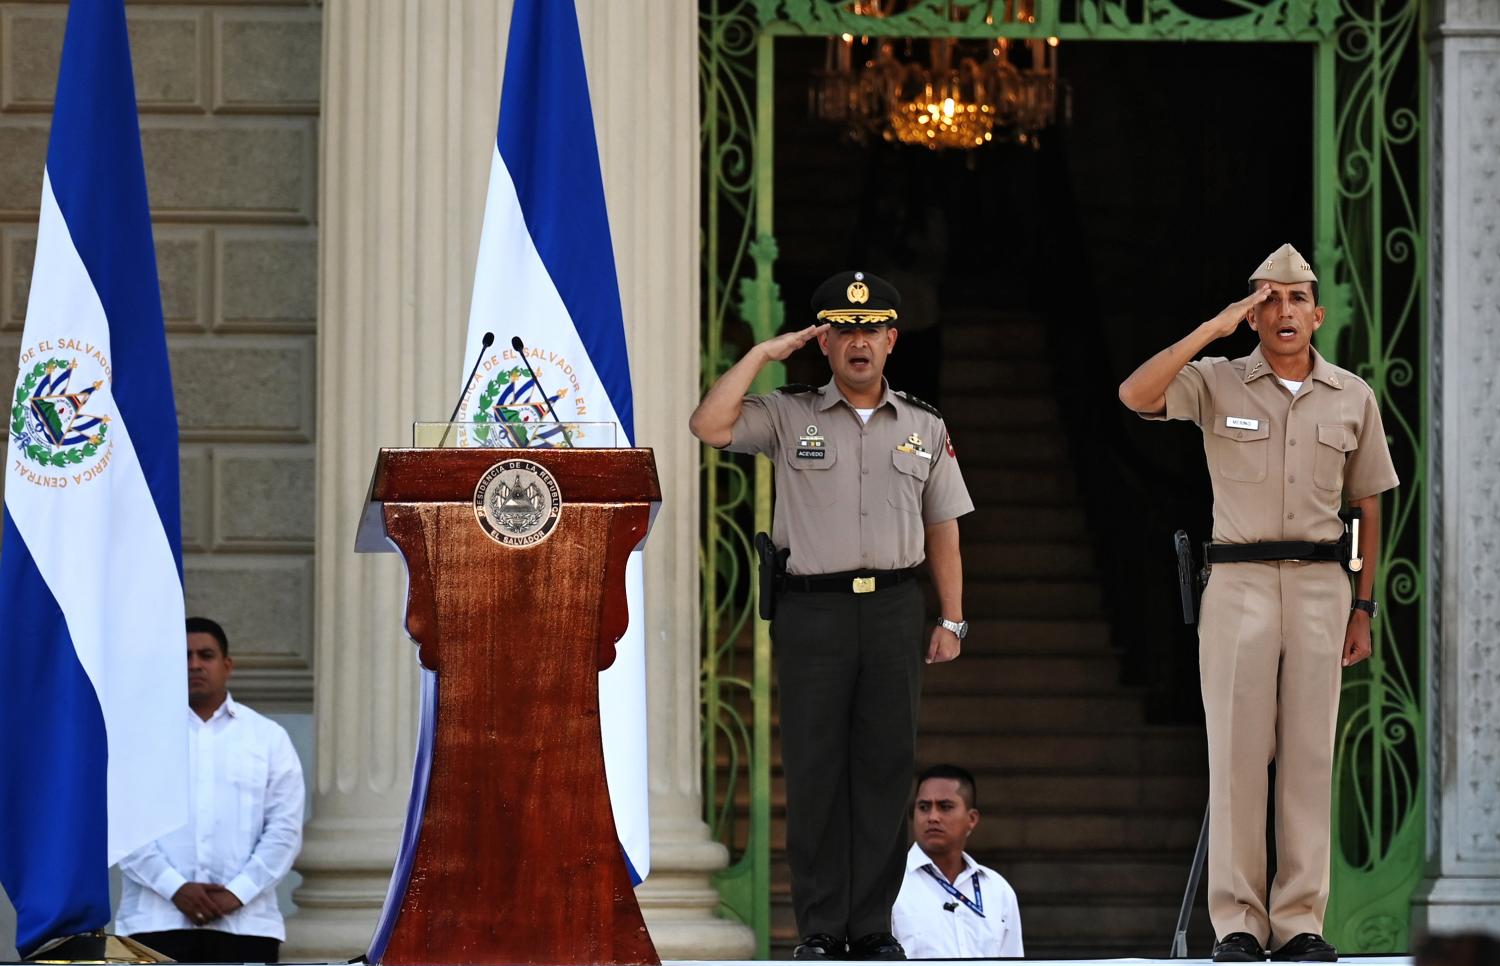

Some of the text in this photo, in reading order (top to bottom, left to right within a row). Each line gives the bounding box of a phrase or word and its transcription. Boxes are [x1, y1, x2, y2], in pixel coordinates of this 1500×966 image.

[21, 348, 36, 364] DE
[39, 340, 53, 352] EL
[483, 355, 500, 372] DE
[502, 349, 518, 361] EL
[523, 347, 581, 393] SALVADOR
[575, 397, 587, 416] EN
[14, 459, 67, 488] CENTRAL
[476, 466, 505, 517] PRESIDENCIA
[525, 463, 536, 472] LA
[539, 472, 559, 518] REPUBLICA
[490, 530, 545, 546] EL SALVADOR
